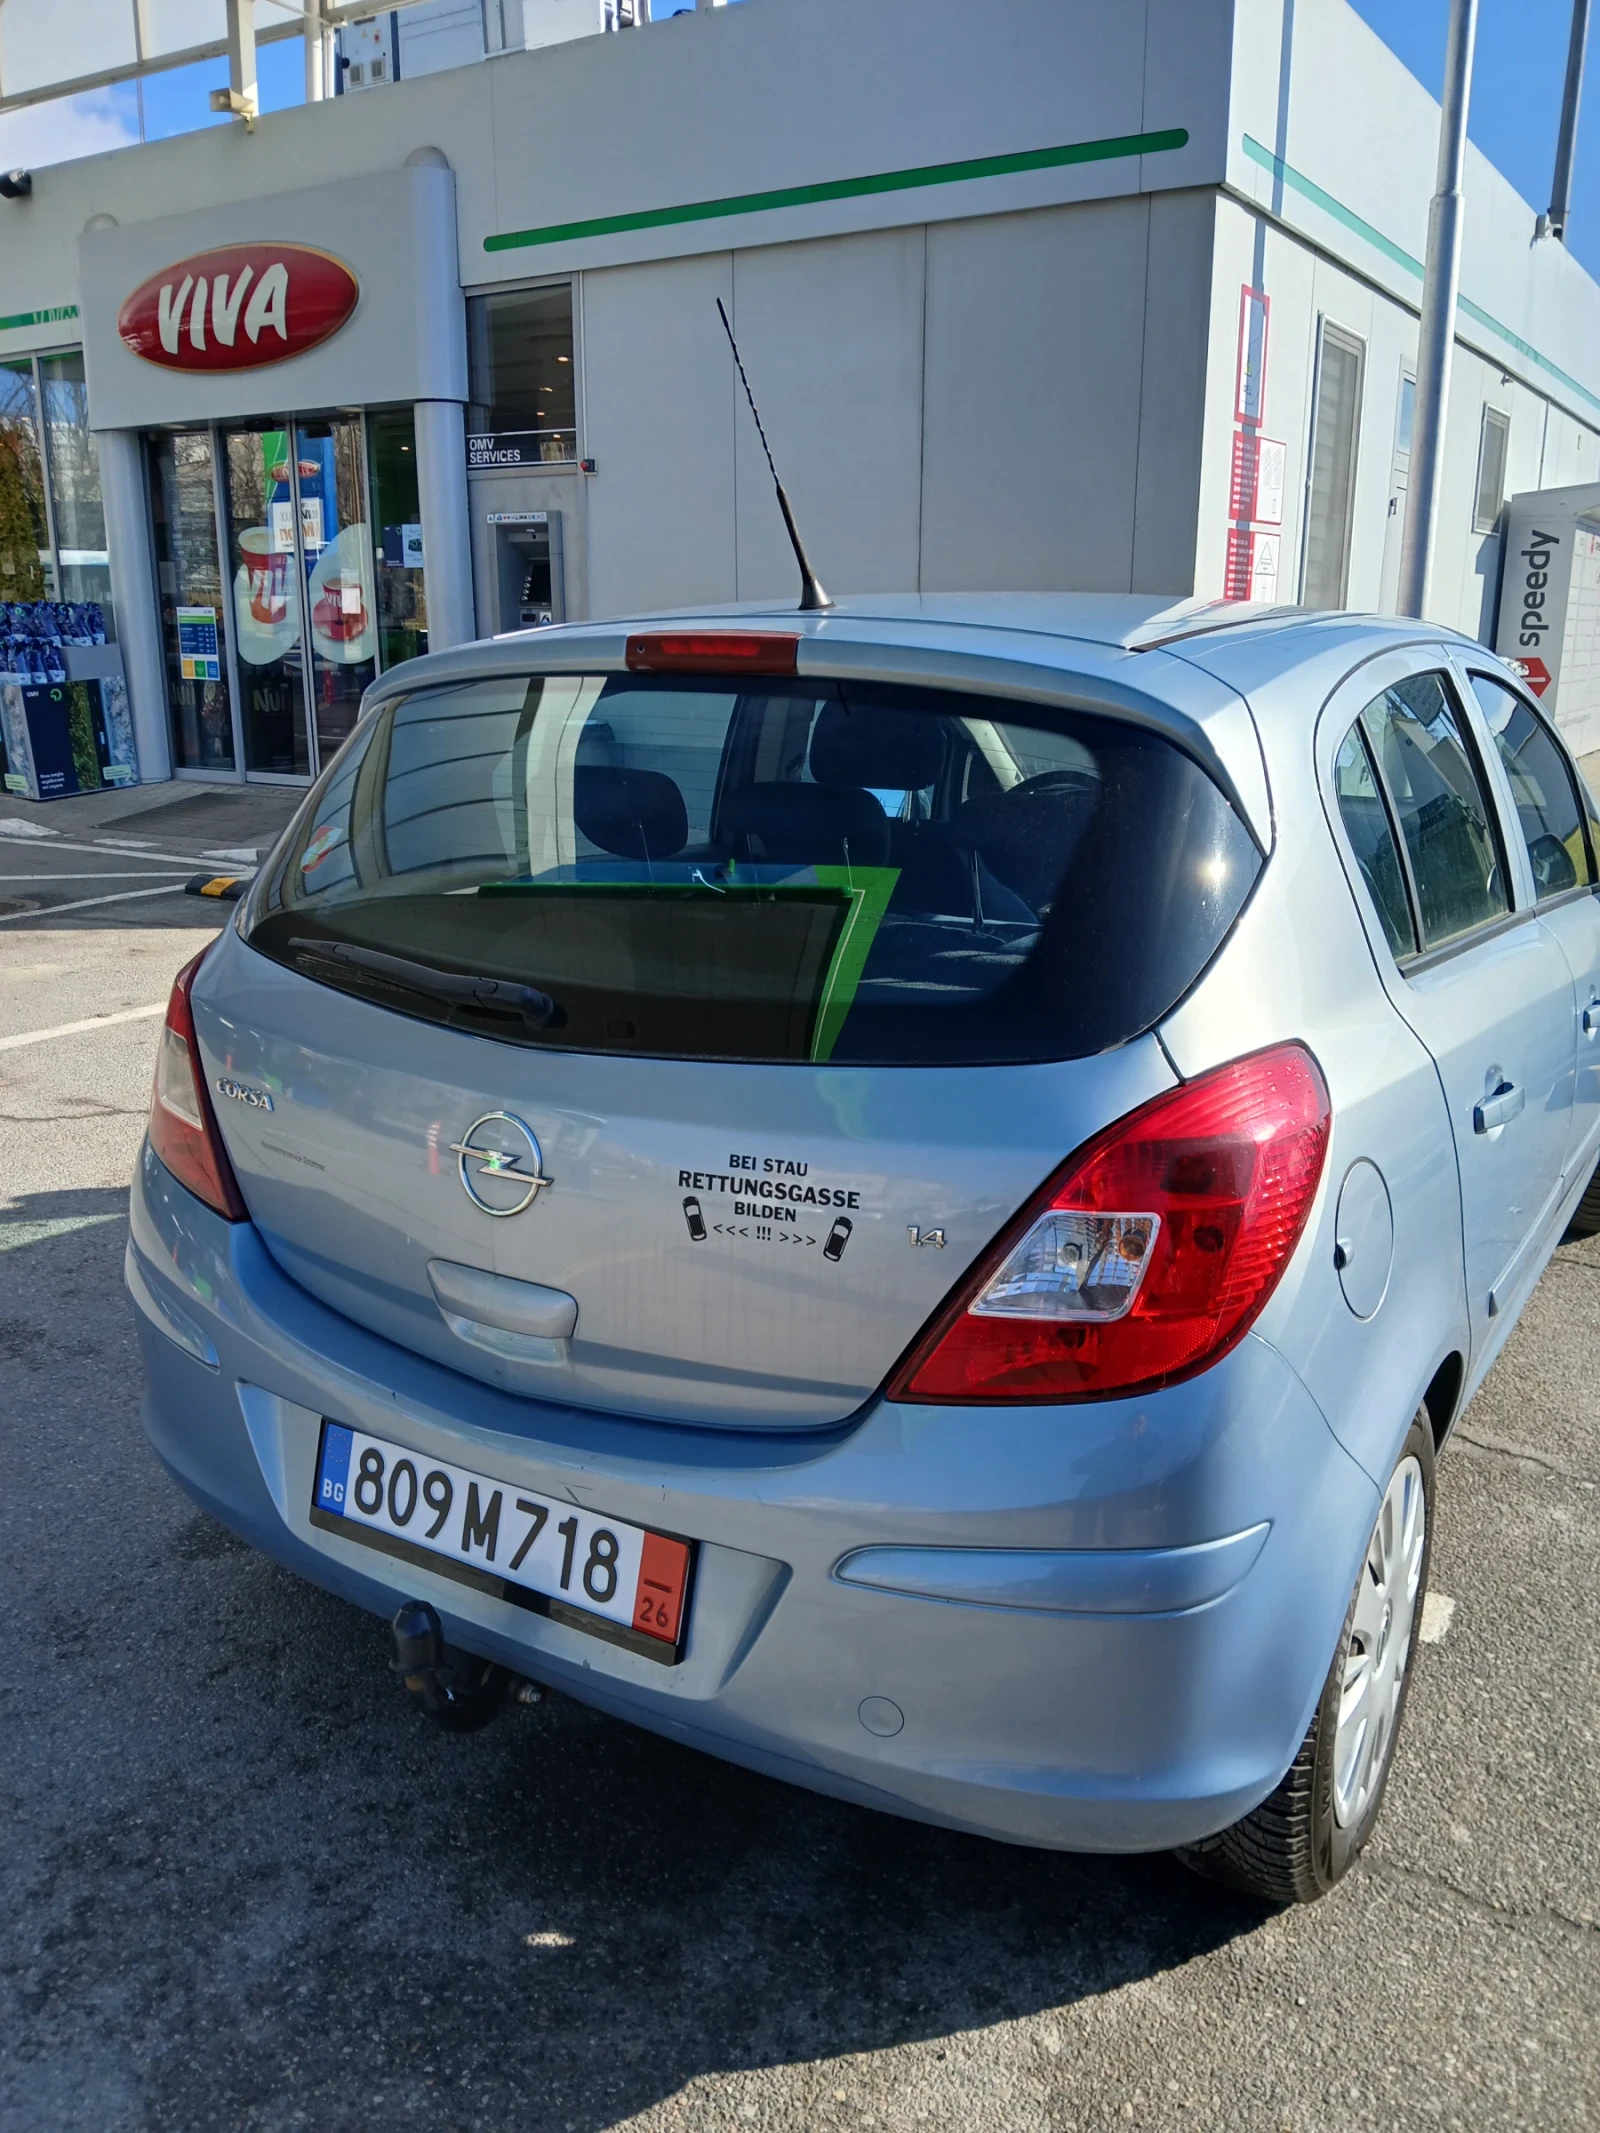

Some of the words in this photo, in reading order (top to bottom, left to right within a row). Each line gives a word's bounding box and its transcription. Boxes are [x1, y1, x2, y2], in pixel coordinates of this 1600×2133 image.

[158, 263, 289, 354] VIVA
[469, 438, 495, 450] OMV
[469, 449, 521, 464] SERVICES
[1519, 529, 1560, 647] speedy
[216, 1077, 275, 1112] CORSA
[728, 1154, 757, 1171] BEI
[763, 1157, 808, 1177] STAU
[678, 1170, 861, 1210] RETTUNGSGASSE
[734, 1201, 797, 1223] BILDEN
[322, 1477, 344, 1503] BG
[354, 1448, 619, 1603] 809M718
[638, 1596, 670, 1628] 26
